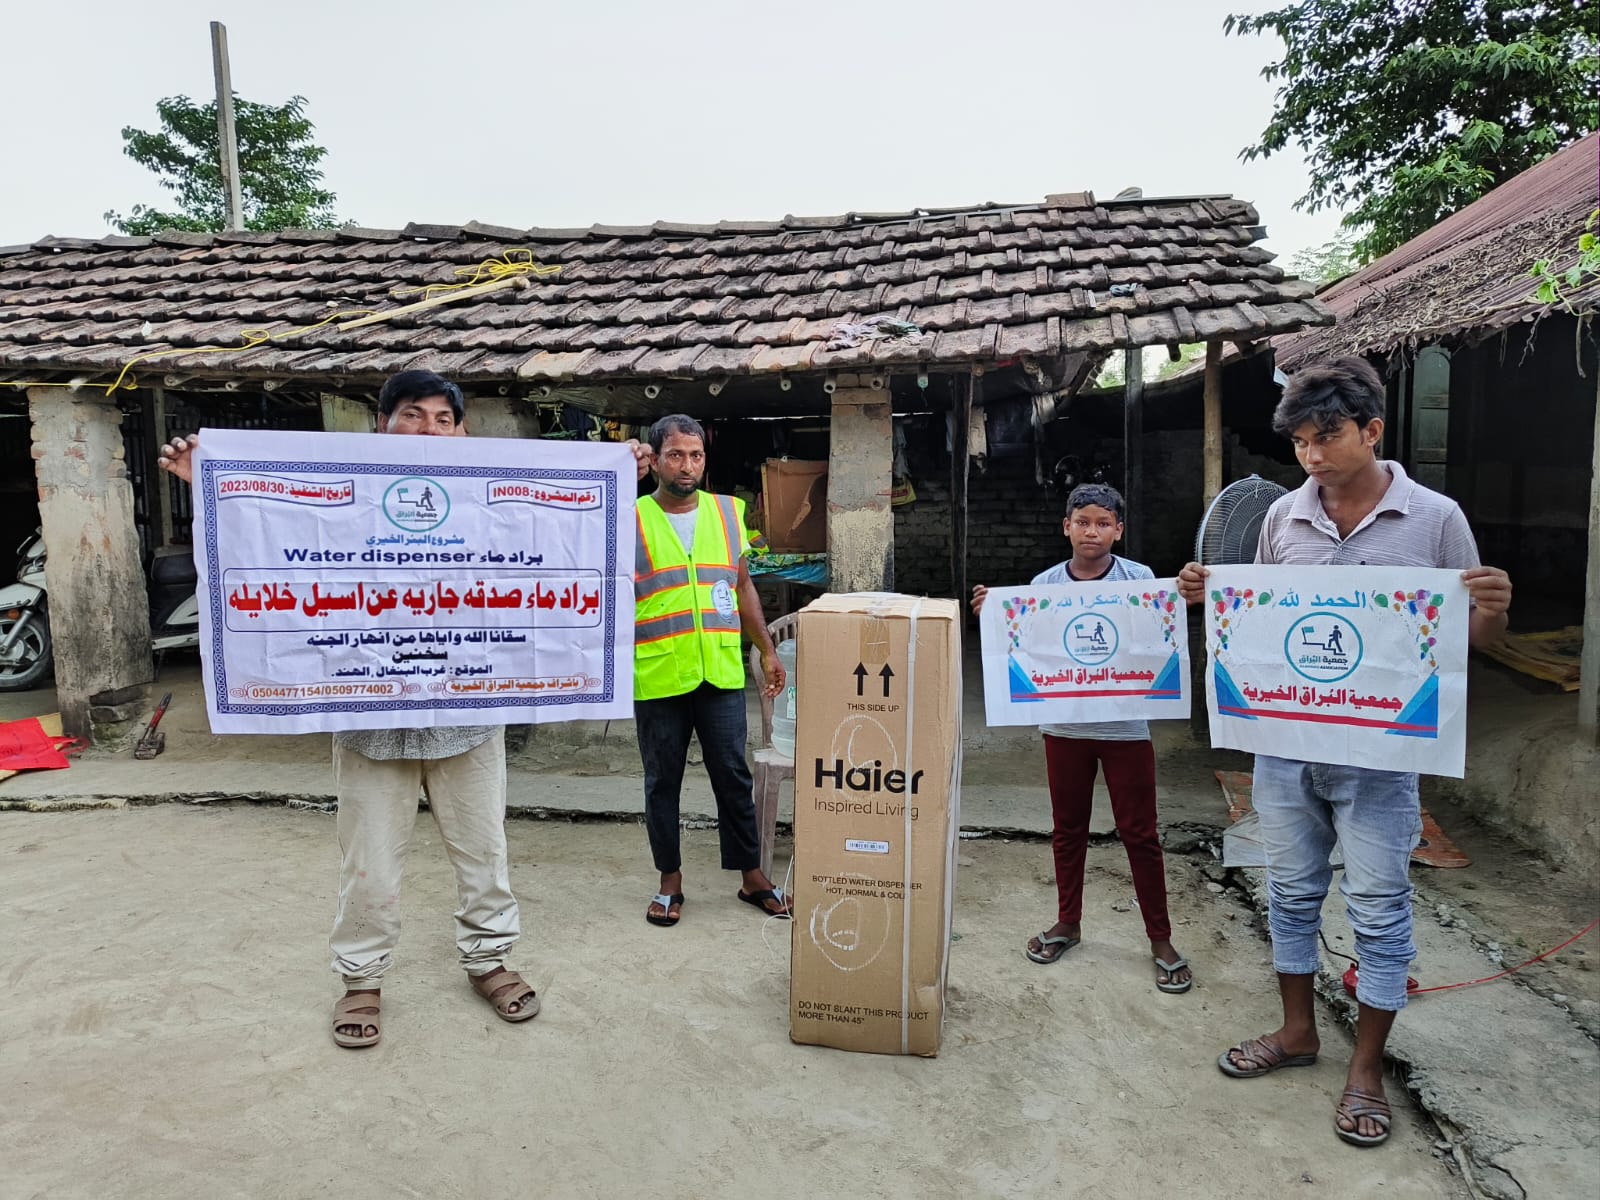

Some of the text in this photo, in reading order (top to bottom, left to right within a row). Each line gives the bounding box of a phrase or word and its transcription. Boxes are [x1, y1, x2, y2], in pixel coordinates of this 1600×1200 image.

[219, 480, 285, 494] 2023/08/30
[326, 485, 352, 500] تاريخ
[493, 485, 530, 498] IN008
[577, 491, 597, 504] رقم
[366, 534, 404, 548] الخيري
[431, 534, 465, 547] مشروع
[284, 548, 543, 566] براد ماء Water dispenser
[229, 580, 600, 618] براد ماء صدقه جاريه عن اسيل خلايله
[1278, 588, 1367, 608] الحمد لله
[306, 632, 349, 649] الجنه
[349, 631, 390, 648] انهار
[392, 634, 417, 647] من
[463, 630, 488, 643] الله
[489, 630, 527, 643] سقانا
[391, 646, 448, 664] سخنين
[1322, 656, 1348, 665] جمعية
[421, 665, 447, 676] غرب
[1031, 668, 1074, 687] الخيرية
[1110, 667, 1155, 684] جمعية
[252, 684, 394, 698] 0504477154/0509774002
[1242, 682, 1298, 703] الخيرية
[846, 702, 901, 713] THIS SIDE UP
[1348, 689, 1404, 713] جمعية
[814, 757, 925, 795] Haier
[813, 796, 872, 816] Inspired
[812, 874, 848, 885] BOTTLED
[848, 877, 876, 887] WATER
[845, 888, 879, 898] NORMAL
[887, 891, 906, 900] COL
[798, 1000, 812, 1009] DO
[813, 1001, 832, 1012] NOT
[833, 1004, 862, 1015] SLANT
[863, 1007, 884, 1017] THIS
[798, 1011, 825, 1021] MORE
[826, 1013, 850, 1023] THAN
